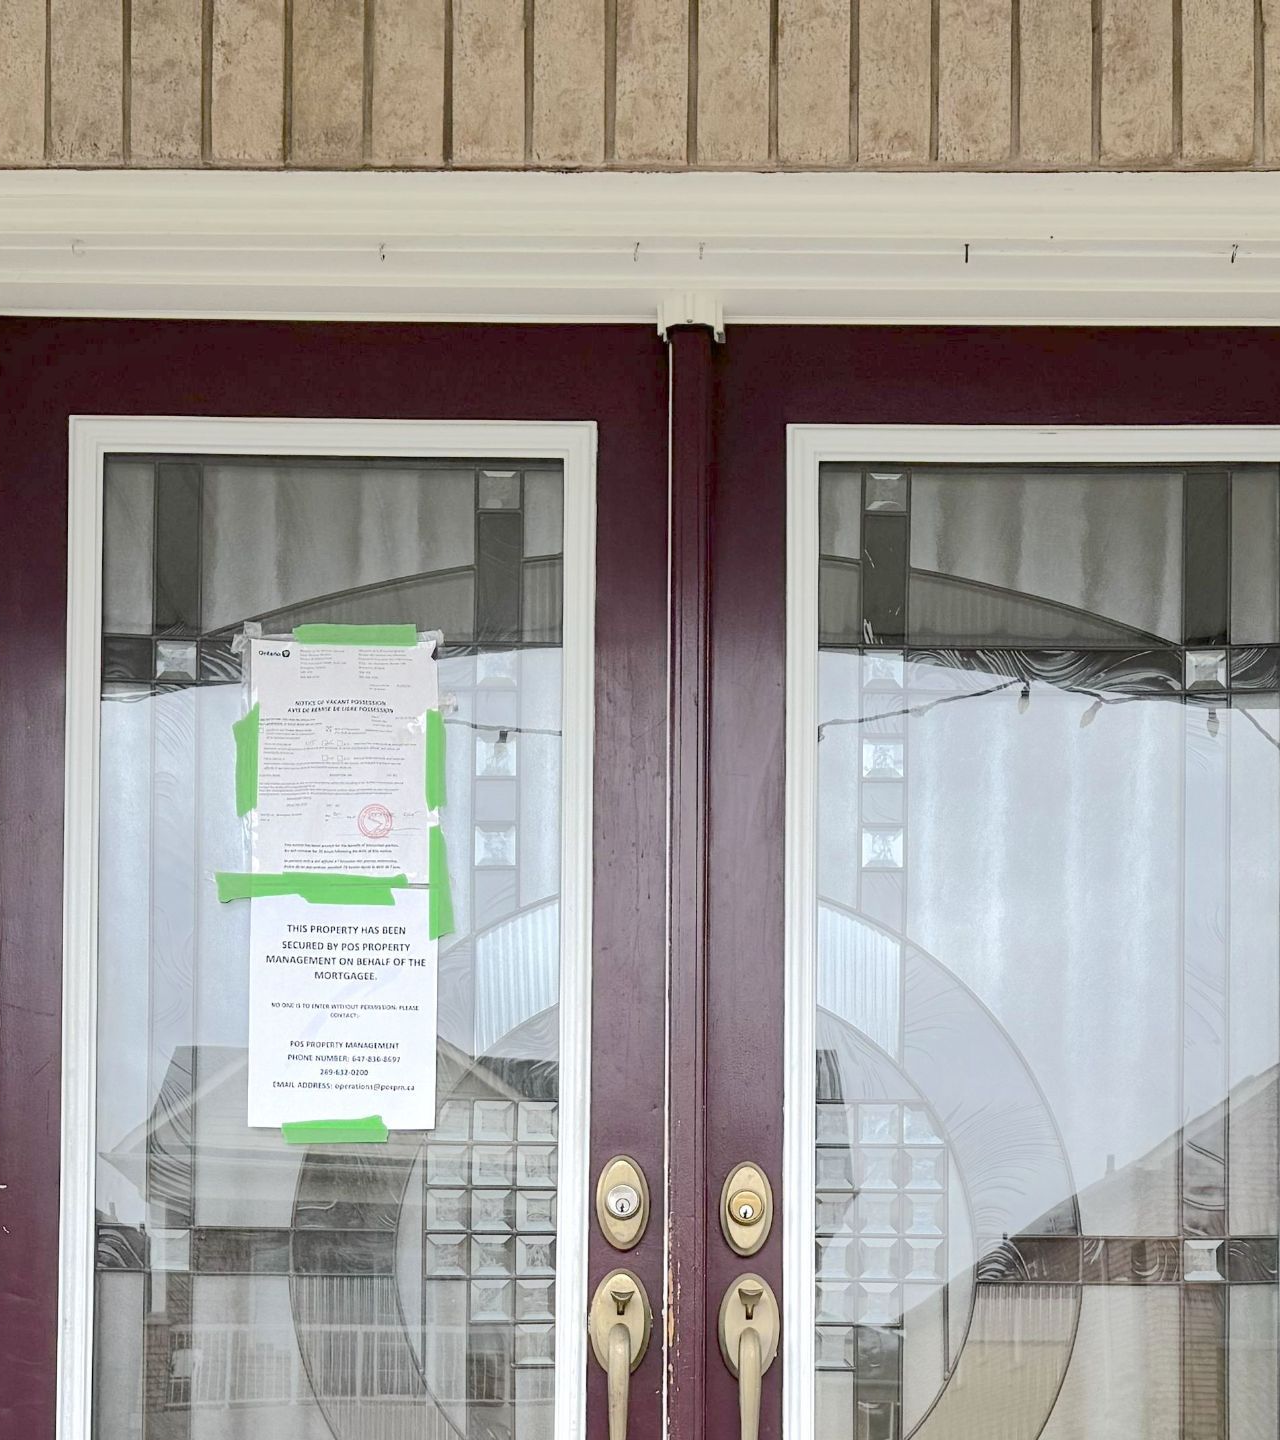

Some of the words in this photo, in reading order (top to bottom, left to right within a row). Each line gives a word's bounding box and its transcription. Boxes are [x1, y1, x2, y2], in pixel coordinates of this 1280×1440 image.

[287, 924, 308, 933] THIS
[310, 925, 359, 935] PROPERTY
[361, 926, 379, 935] HAS
[382, 926, 406, 935] BEEN
[282, 941, 324, 950] SECURED
[327, 942, 339, 951] BY
[341, 942, 360, 951] POS
[362, 942, 411, 952] PROPERTY
[265, 955, 336, 966] MANAGEMENT
[339, 957, 354, 966] ON
[356, 957, 391, 966] BEHALF
[393, 958, 406, 967] OF
[409, 958, 427, 967] THE
[314, 971, 378, 981] MORTGAGEE.
[290, 1040, 304, 1048] POS
[306, 1041, 343, 1049] PROPERTY
[345, 1042, 399, 1050] MANAGEMENT
[272, 1081, 295, 1089] EMAIL
[297, 1082, 333, 1090] ADDRESS:
